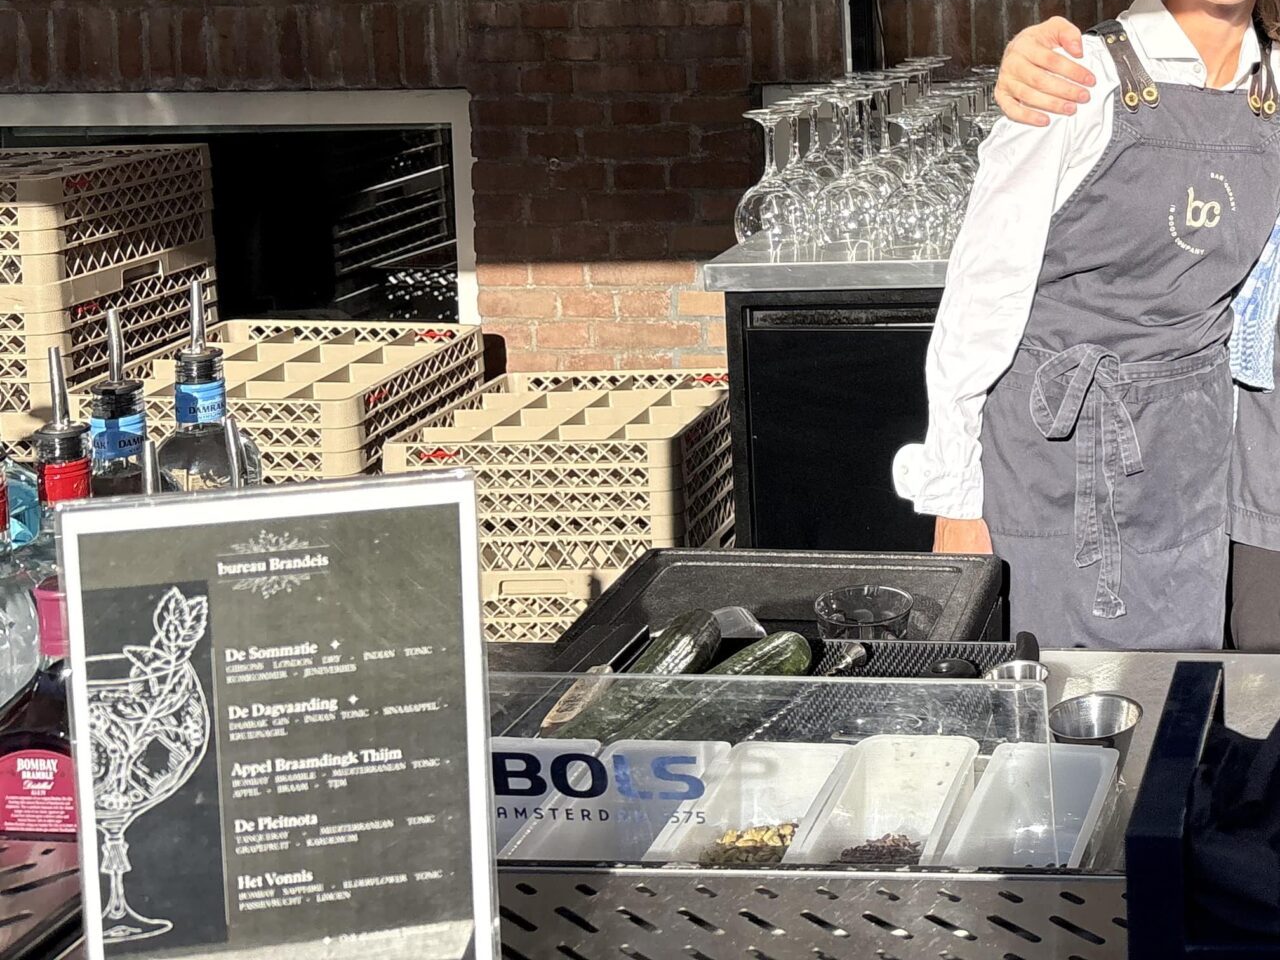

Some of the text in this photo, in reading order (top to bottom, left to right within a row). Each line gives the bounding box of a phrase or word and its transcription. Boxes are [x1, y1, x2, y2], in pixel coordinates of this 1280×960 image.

[1185, 186, 1221, 228] bc
[217, 553, 330, 575] bureau Brandeis
[224, 641, 319, 663] De Sommatie
[403, 646, 433, 657] TONIC
[227, 697, 339, 720] De Dagvaarding
[16, 757, 59, 773] BOMBAY
[230, 747, 403, 779] Appel Braamdingk Thijm
[411, 757, 441, 770] TONIC
[21, 771, 55, 780] BRAMBLE
[492, 751, 706, 801] BOLS
[234, 813, 319, 834] De Pleitnota
[405, 814, 436, 826] TONIC
[237, 868, 315, 890] Het Vonnis
[413, 869, 444, 882] TONIC
